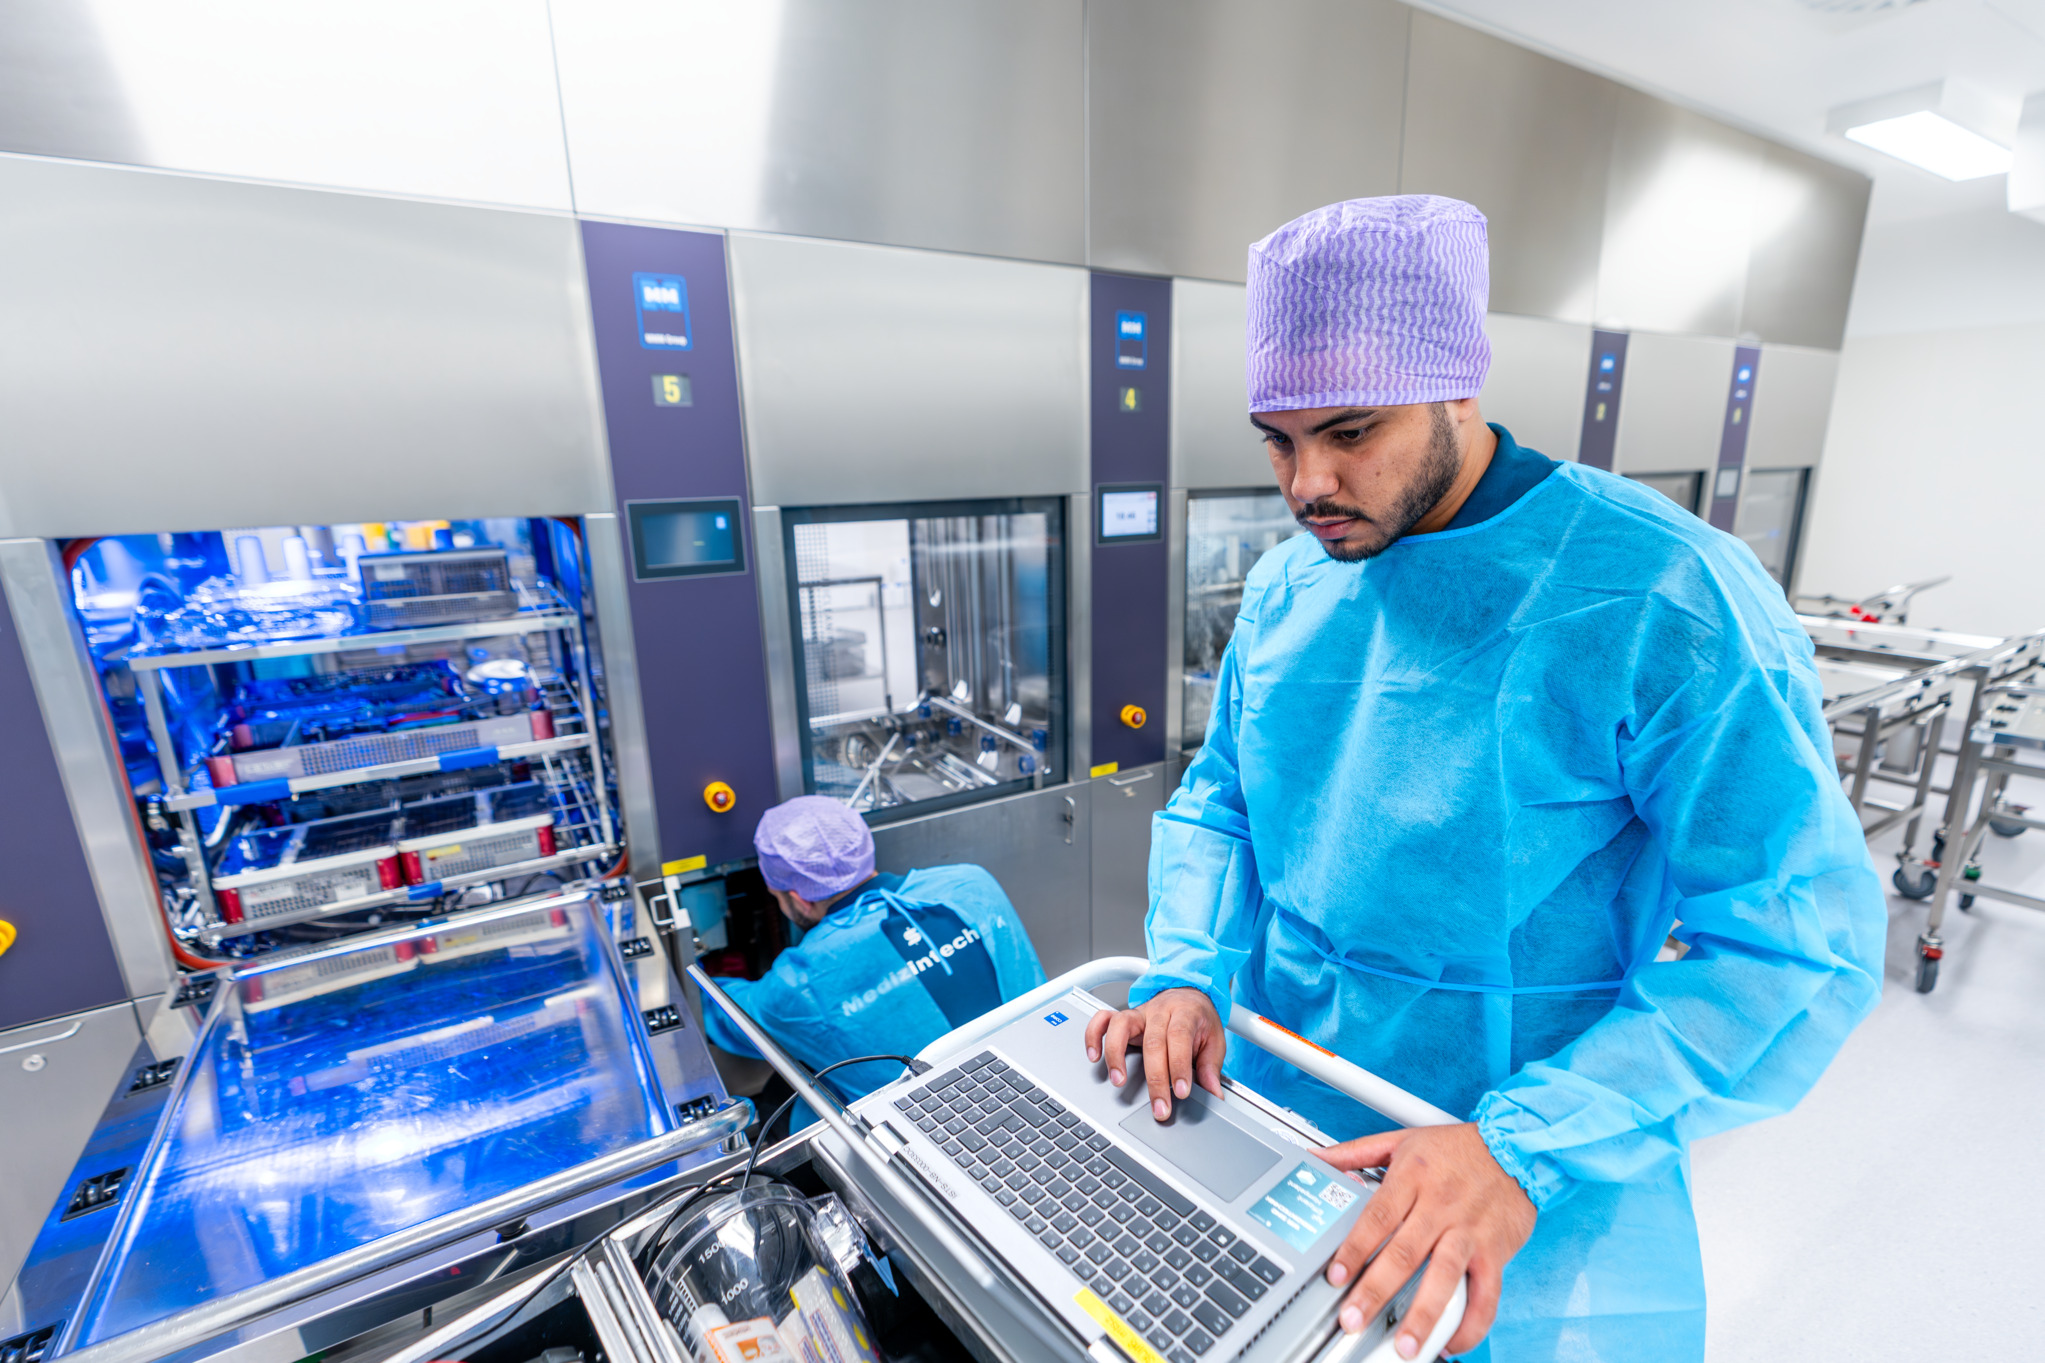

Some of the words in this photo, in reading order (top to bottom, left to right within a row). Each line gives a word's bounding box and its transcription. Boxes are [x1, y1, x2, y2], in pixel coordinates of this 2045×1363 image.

[662, 375, 681, 403] 5
[1124, 388, 1136, 410] 4
[841, 915, 1006, 1016] Medizintech
[721, 1277, 749, 1305] 1000
